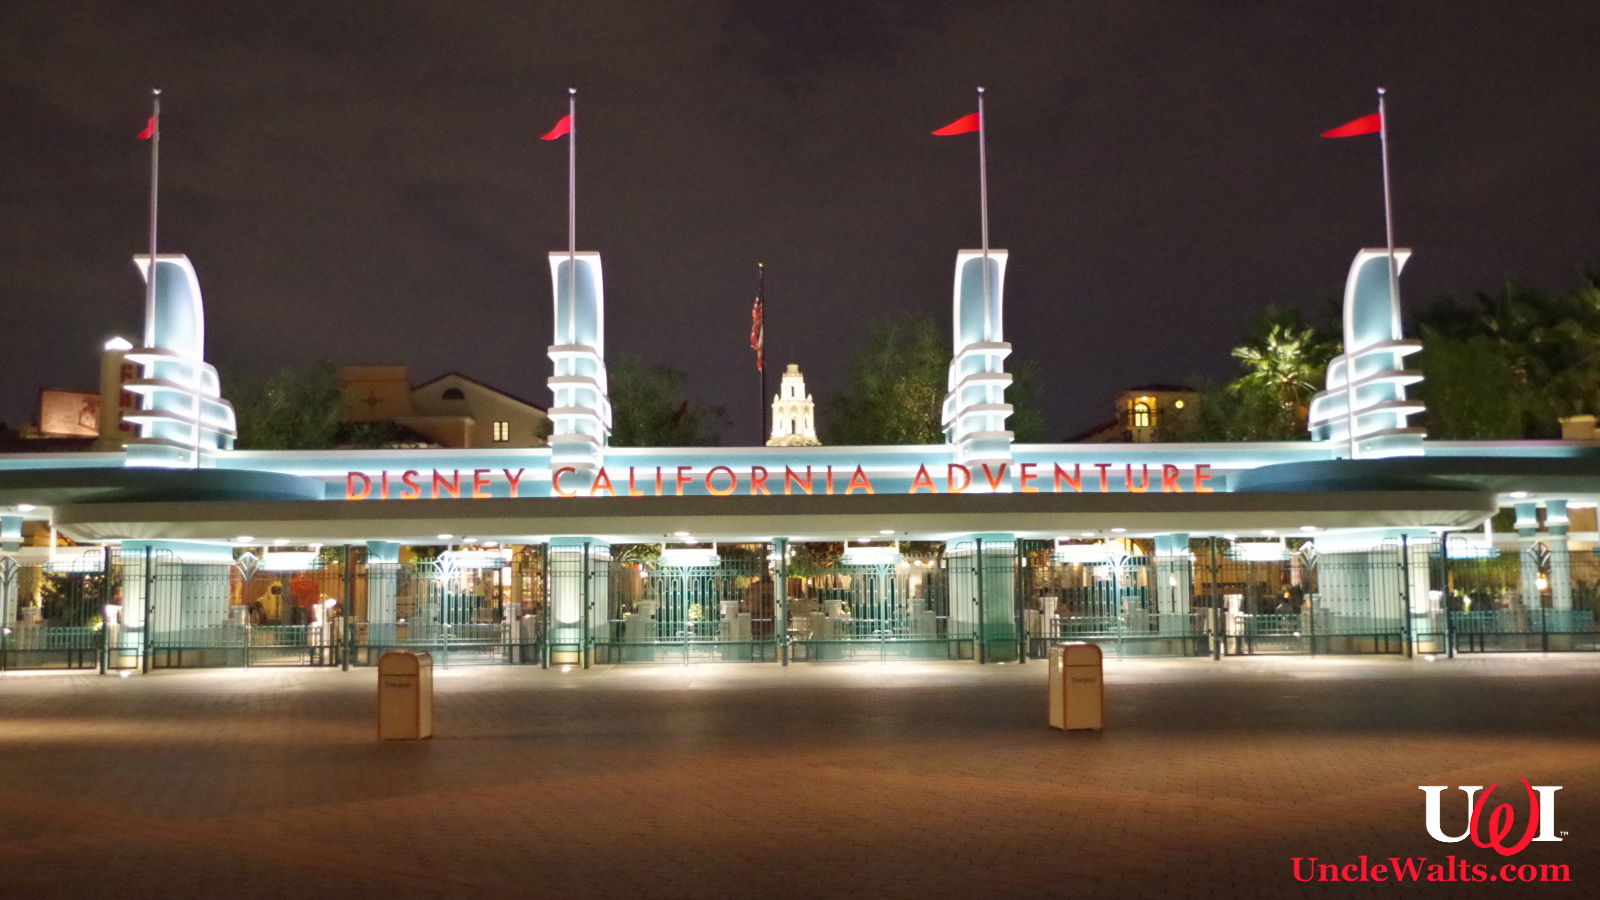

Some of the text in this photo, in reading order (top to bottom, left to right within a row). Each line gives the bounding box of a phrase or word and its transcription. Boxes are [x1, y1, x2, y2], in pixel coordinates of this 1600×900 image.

[346, 462, 1215, 500] DISNEY CALIFORNIA ADVENTURE
